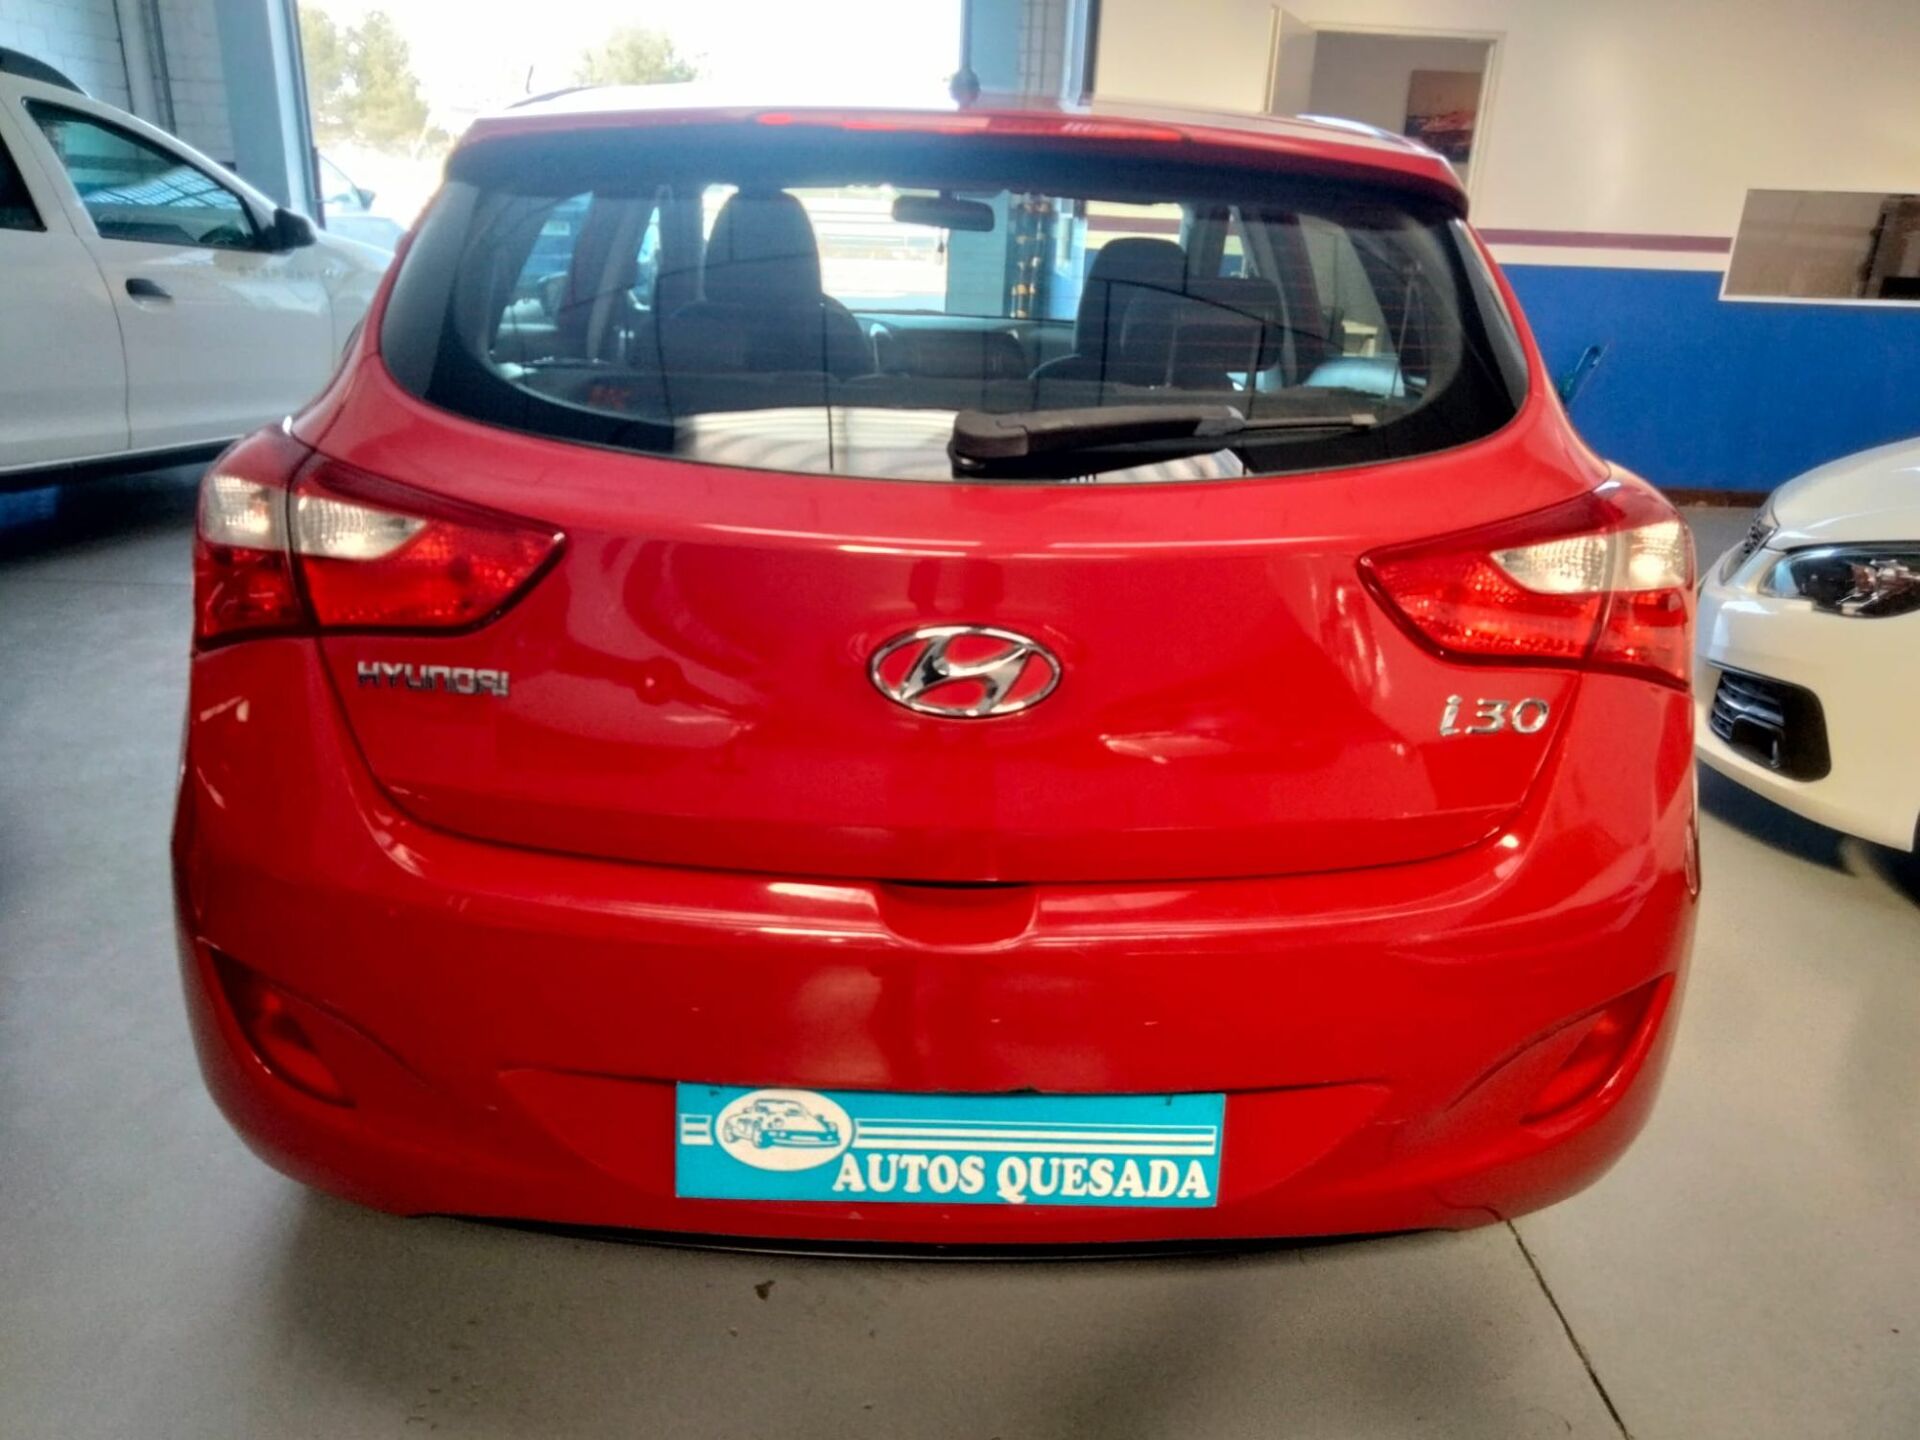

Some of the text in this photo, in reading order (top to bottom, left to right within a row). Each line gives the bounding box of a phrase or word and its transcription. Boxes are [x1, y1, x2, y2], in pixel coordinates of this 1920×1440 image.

[357, 661, 509, 696] HYUNDAI
[1440, 694, 1550, 736] i30
[832, 1153, 1211, 1204] AUTOS QUESADA
